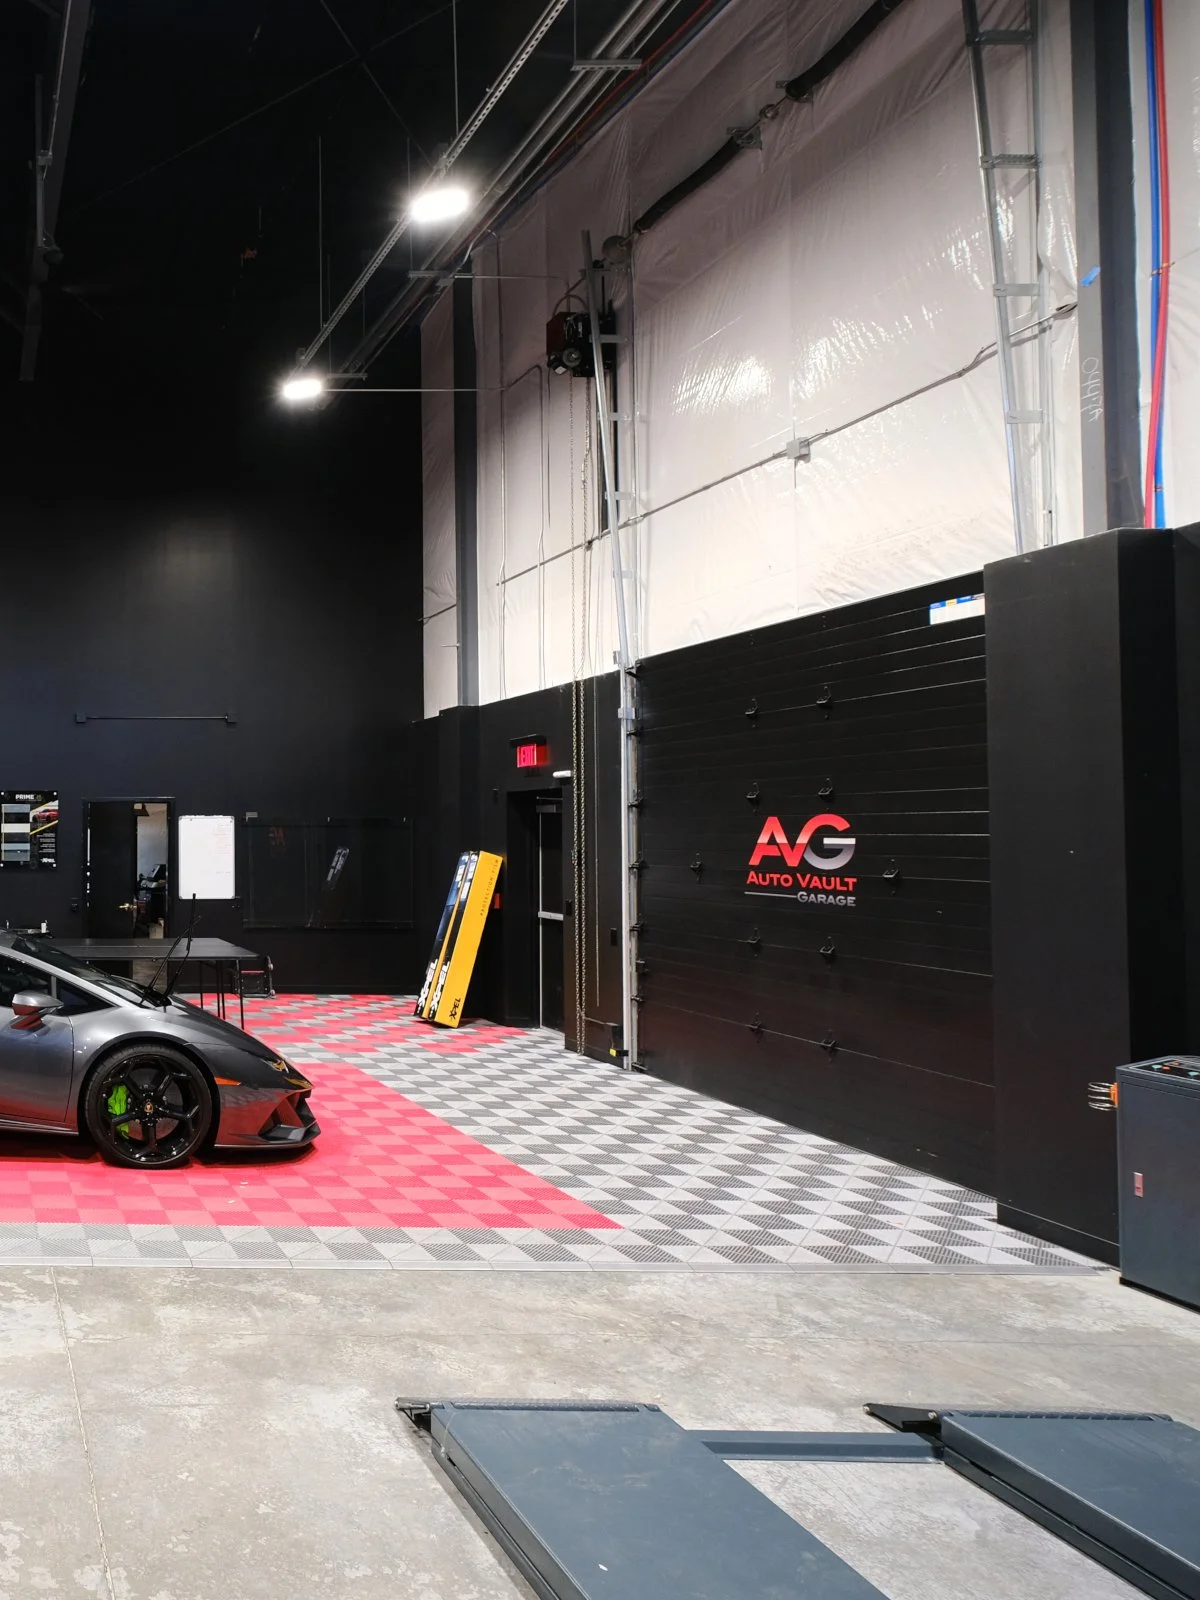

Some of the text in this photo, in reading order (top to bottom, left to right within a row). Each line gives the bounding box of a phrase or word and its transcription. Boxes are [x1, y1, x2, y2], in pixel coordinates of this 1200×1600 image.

[746, 870, 857, 891] AUTO VAULT
[797, 891, 856, 906] GARAGE
[449, 998, 461, 1019] XPEL
